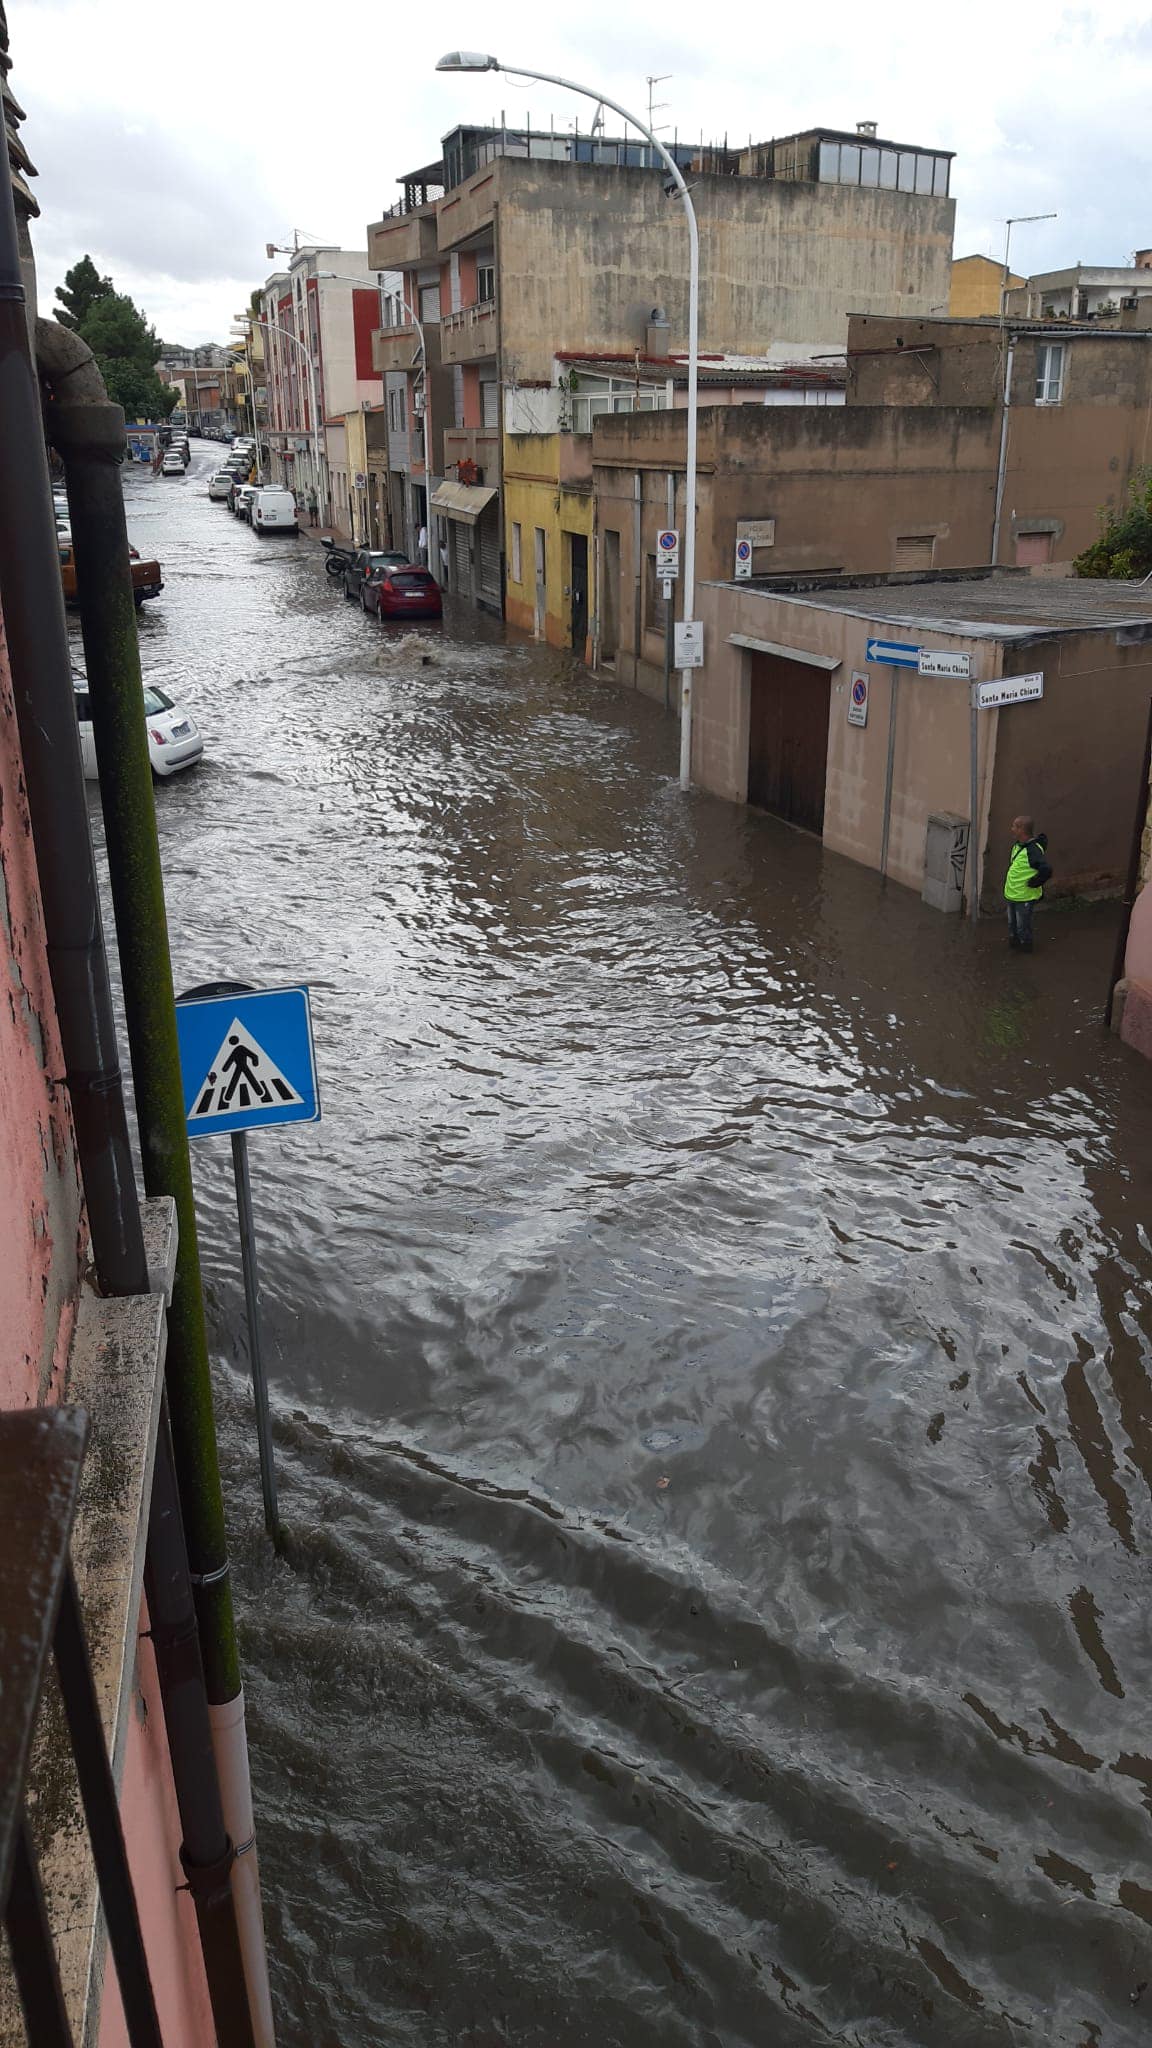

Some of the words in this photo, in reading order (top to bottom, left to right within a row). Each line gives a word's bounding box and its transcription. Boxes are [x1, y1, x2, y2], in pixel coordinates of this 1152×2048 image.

[921, 662, 936, 672] Santa
[937, 663, 951, 674] Maria
[952, 664, 969, 674] Chiara
[981, 692, 999, 704] Santa
[1001, 689, 1018, 701] Maria
[1020, 687, 1039, 696] Chiara
